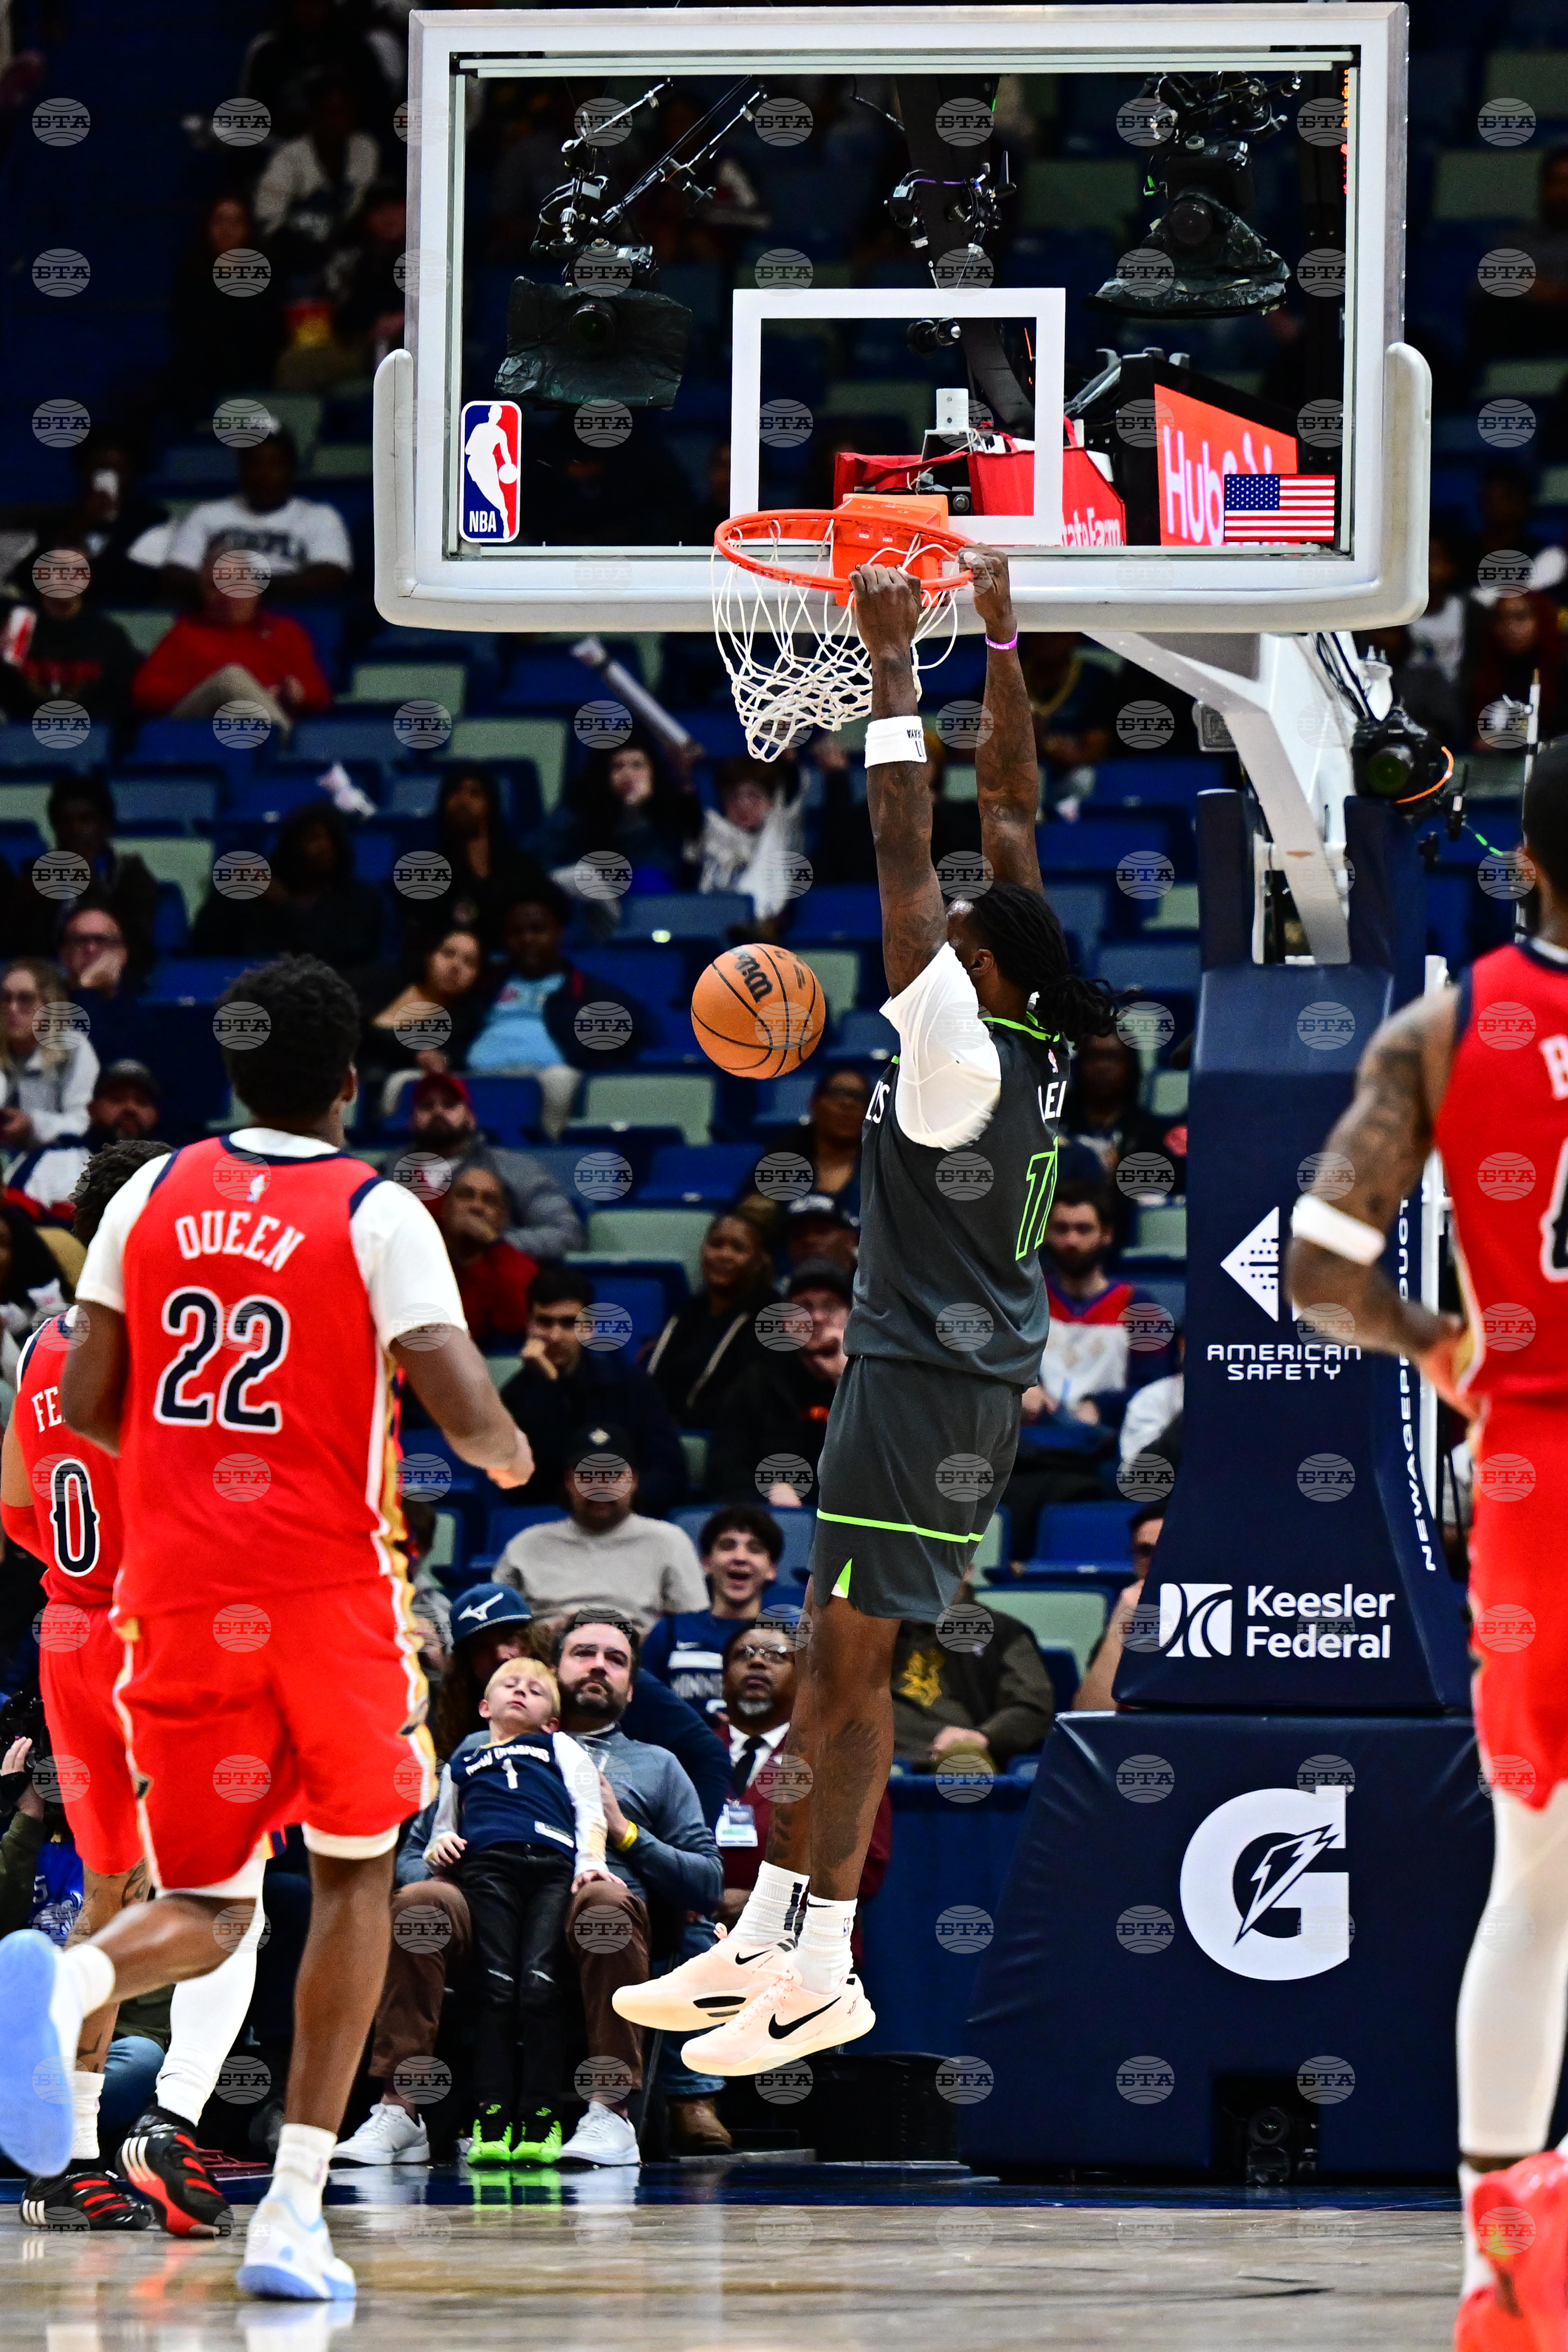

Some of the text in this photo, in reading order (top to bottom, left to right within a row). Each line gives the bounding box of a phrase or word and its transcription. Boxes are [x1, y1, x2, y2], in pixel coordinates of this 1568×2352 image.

[469, 510, 497, 533] NBA
[175, 1209, 305, 1272] QUEEN
[153, 1286, 292, 1434] 22
[1207, 1344, 1362, 1361] AMERICAN
[1227, 1364, 1341, 1381] SAFETY
[32, 1386, 66, 1433] FE
[50, 1458, 100, 1577] 0
[1247, 1583, 1396, 1618] Keesler
[1246, 1625, 1391, 1659] Federal
